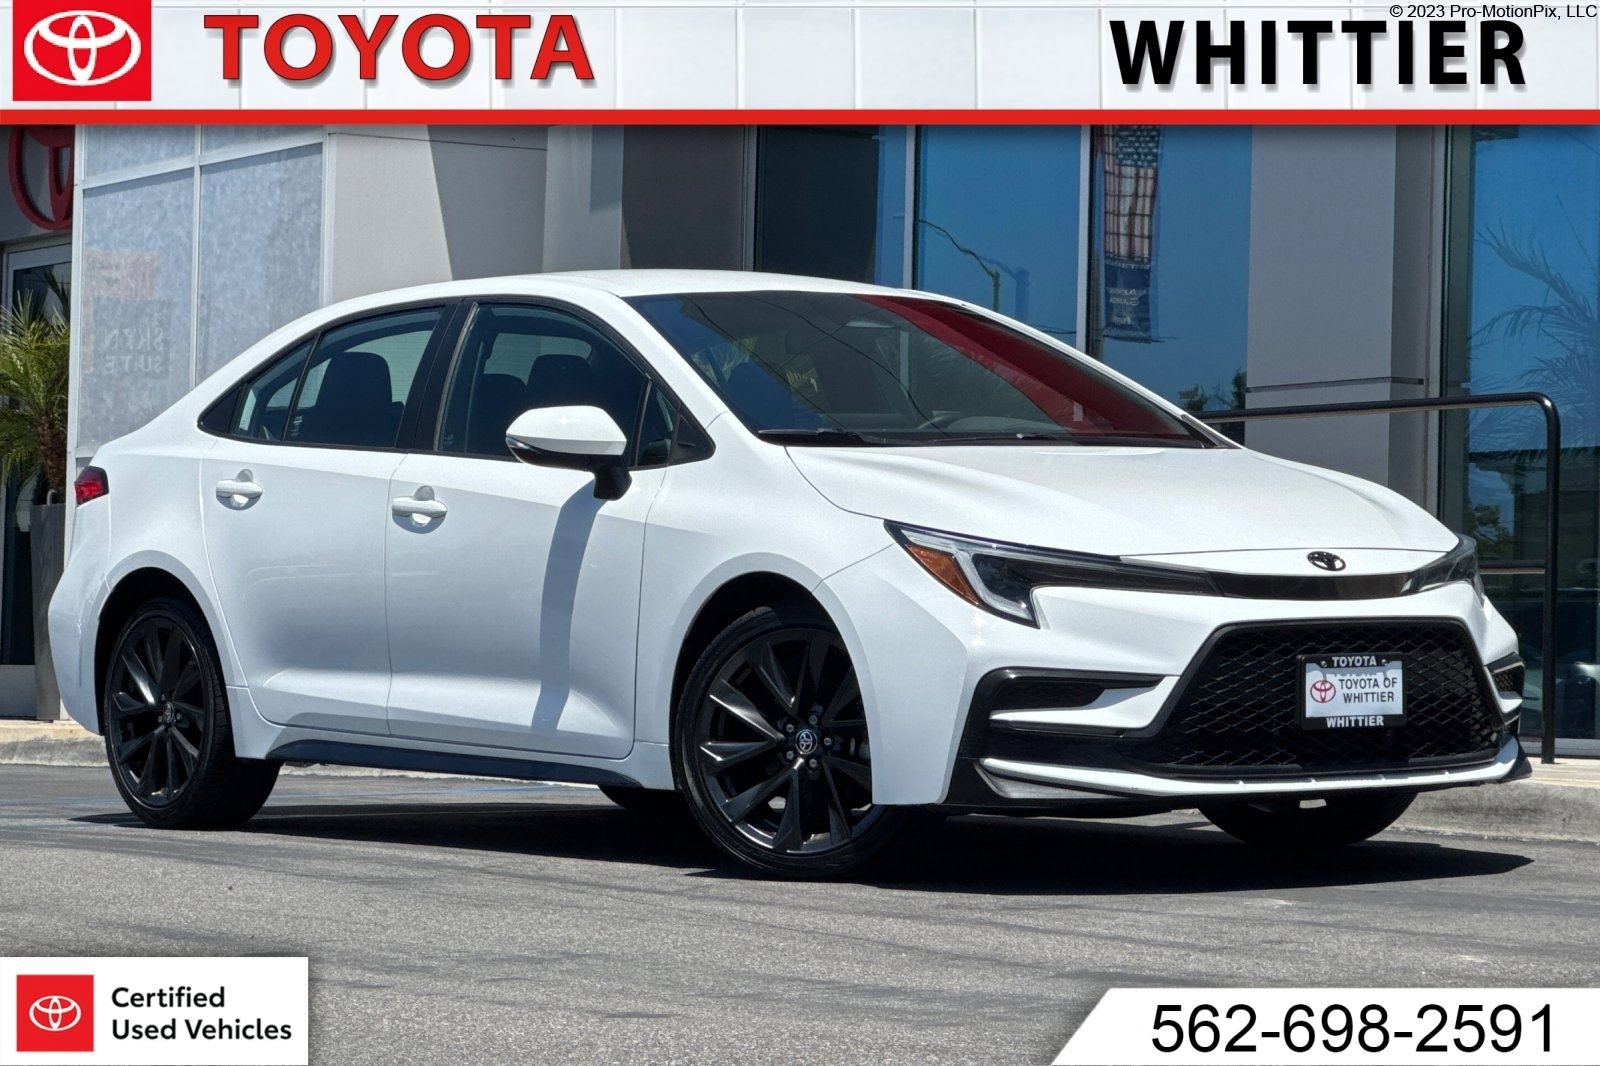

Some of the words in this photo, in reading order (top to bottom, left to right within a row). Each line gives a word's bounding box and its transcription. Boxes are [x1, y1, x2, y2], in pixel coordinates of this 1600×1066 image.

[1331, 655, 1377, 667] TOYOTA
[1338, 678, 1379, 690] TOYOTA
[1383, 677, 1398, 689] OF
[1343, 691, 1394, 703] WHITTIER
[1326, 715, 1384, 728] WHITTIER
